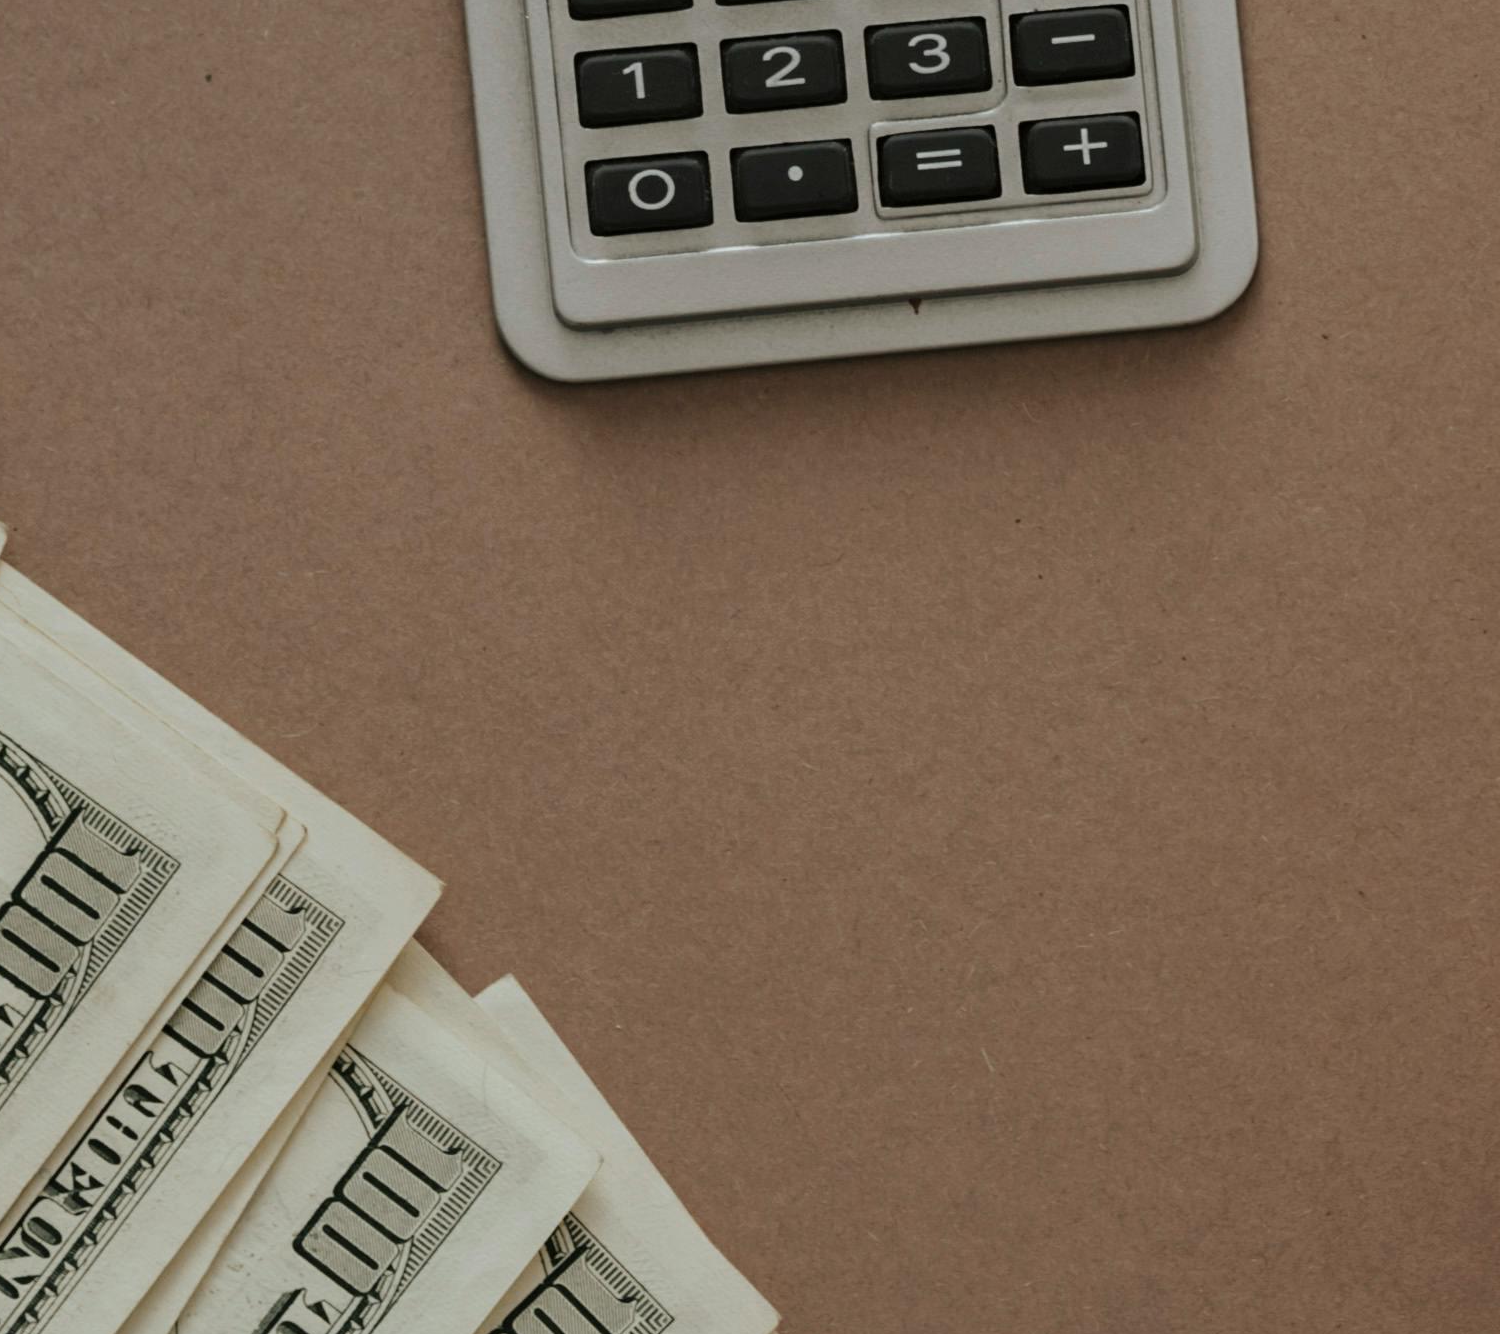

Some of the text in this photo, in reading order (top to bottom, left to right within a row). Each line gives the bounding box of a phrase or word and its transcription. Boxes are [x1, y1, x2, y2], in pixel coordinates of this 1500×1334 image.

[763, 47, 805, 87] 2
[909, 34, 950, 73] 3
[623, 63, 645, 98] 1
[629, 170, 675, 209] 0
[160, 883, 314, 1063] 100
[42, 1047, 189, 1221] THE
[288, 1100, 473, 1305] 100
